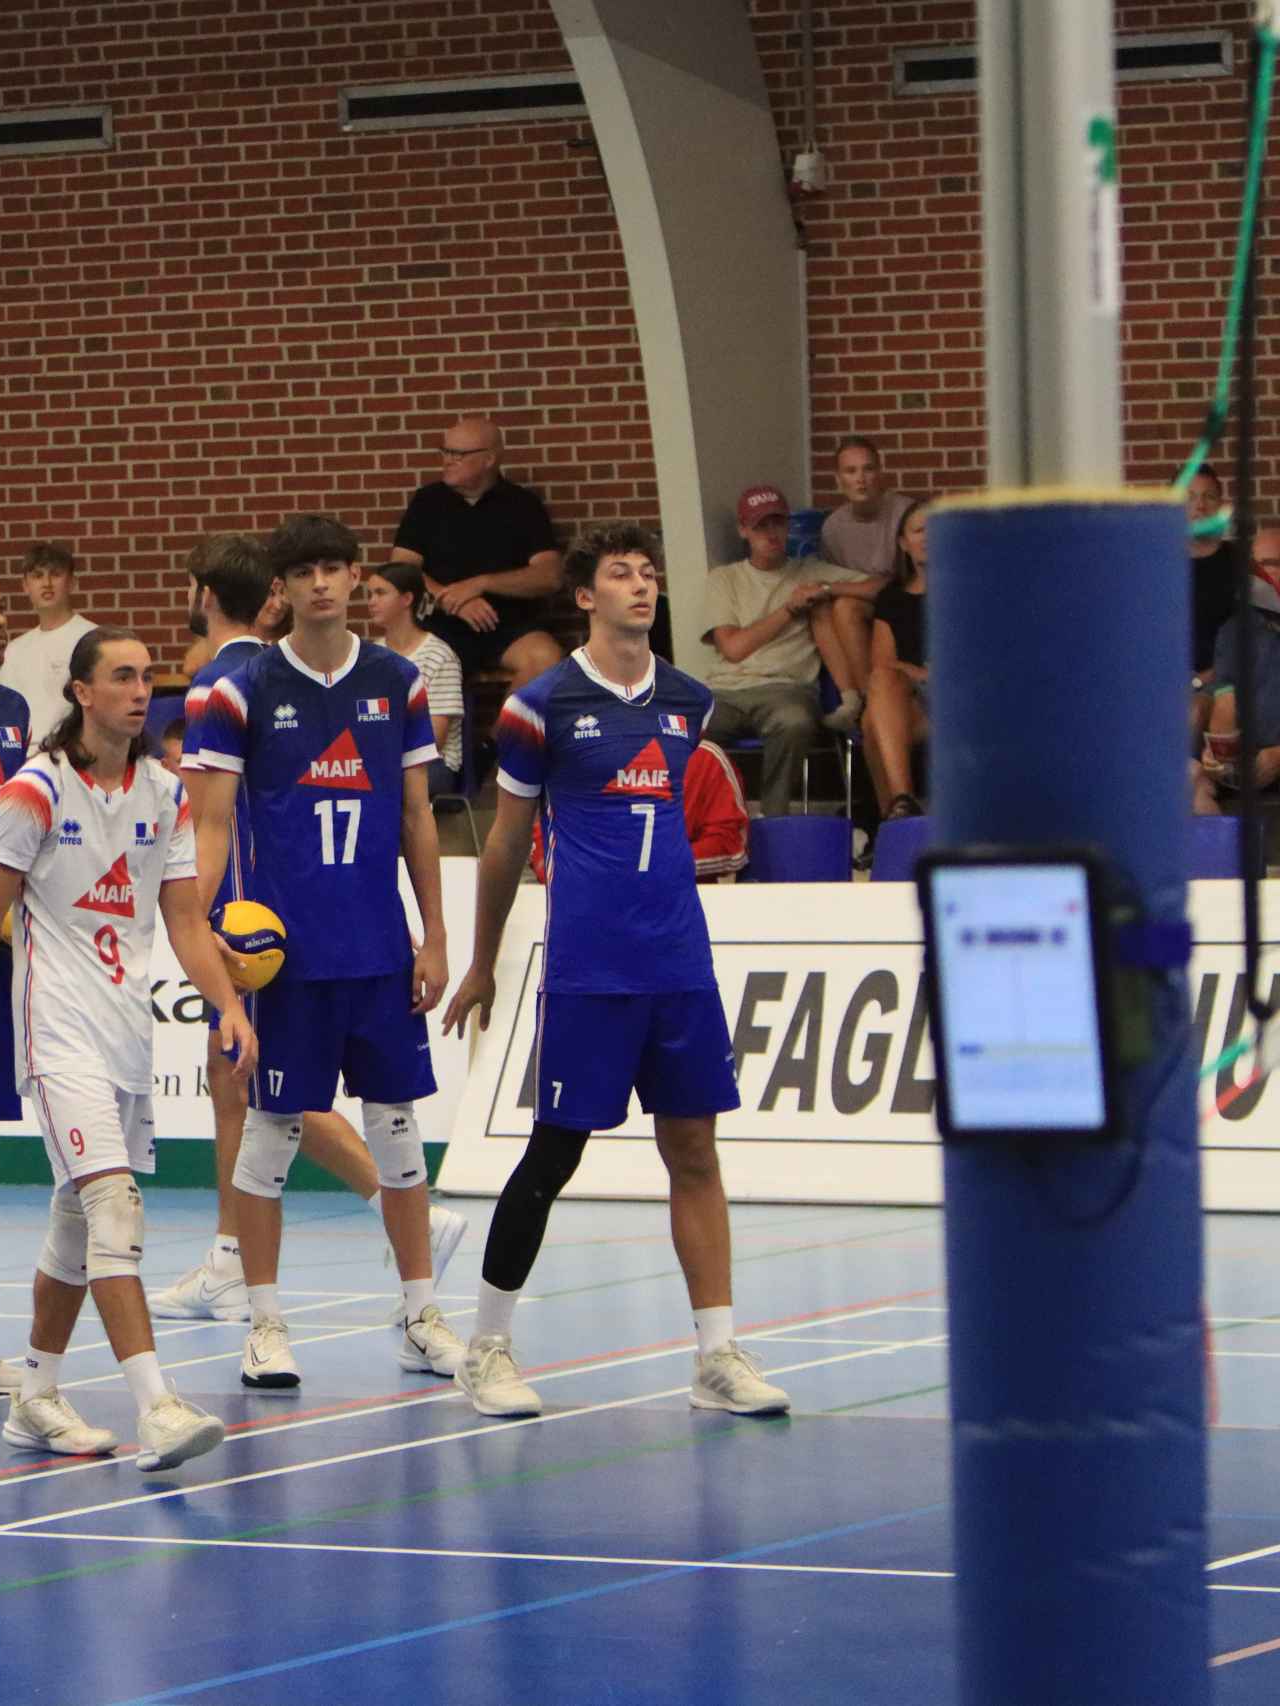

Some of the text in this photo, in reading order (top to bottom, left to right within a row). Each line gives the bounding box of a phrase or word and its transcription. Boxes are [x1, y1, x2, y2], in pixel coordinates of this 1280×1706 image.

[357, 713, 390, 722] FRANCE
[310, 758, 363, 779] MAIF
[616, 769, 669, 788] MAIF
[314, 799, 362, 865] 17
[630, 803, 656, 872] 7
[88, 884, 136, 904] MAIF
[94, 924, 125, 985] 9
[732, 969, 934, 1115] FAGL
[268, 1069, 284, 1097] 17
[552, 1080, 563, 1109] 7
[70, 1127, 85, 1157] 9
